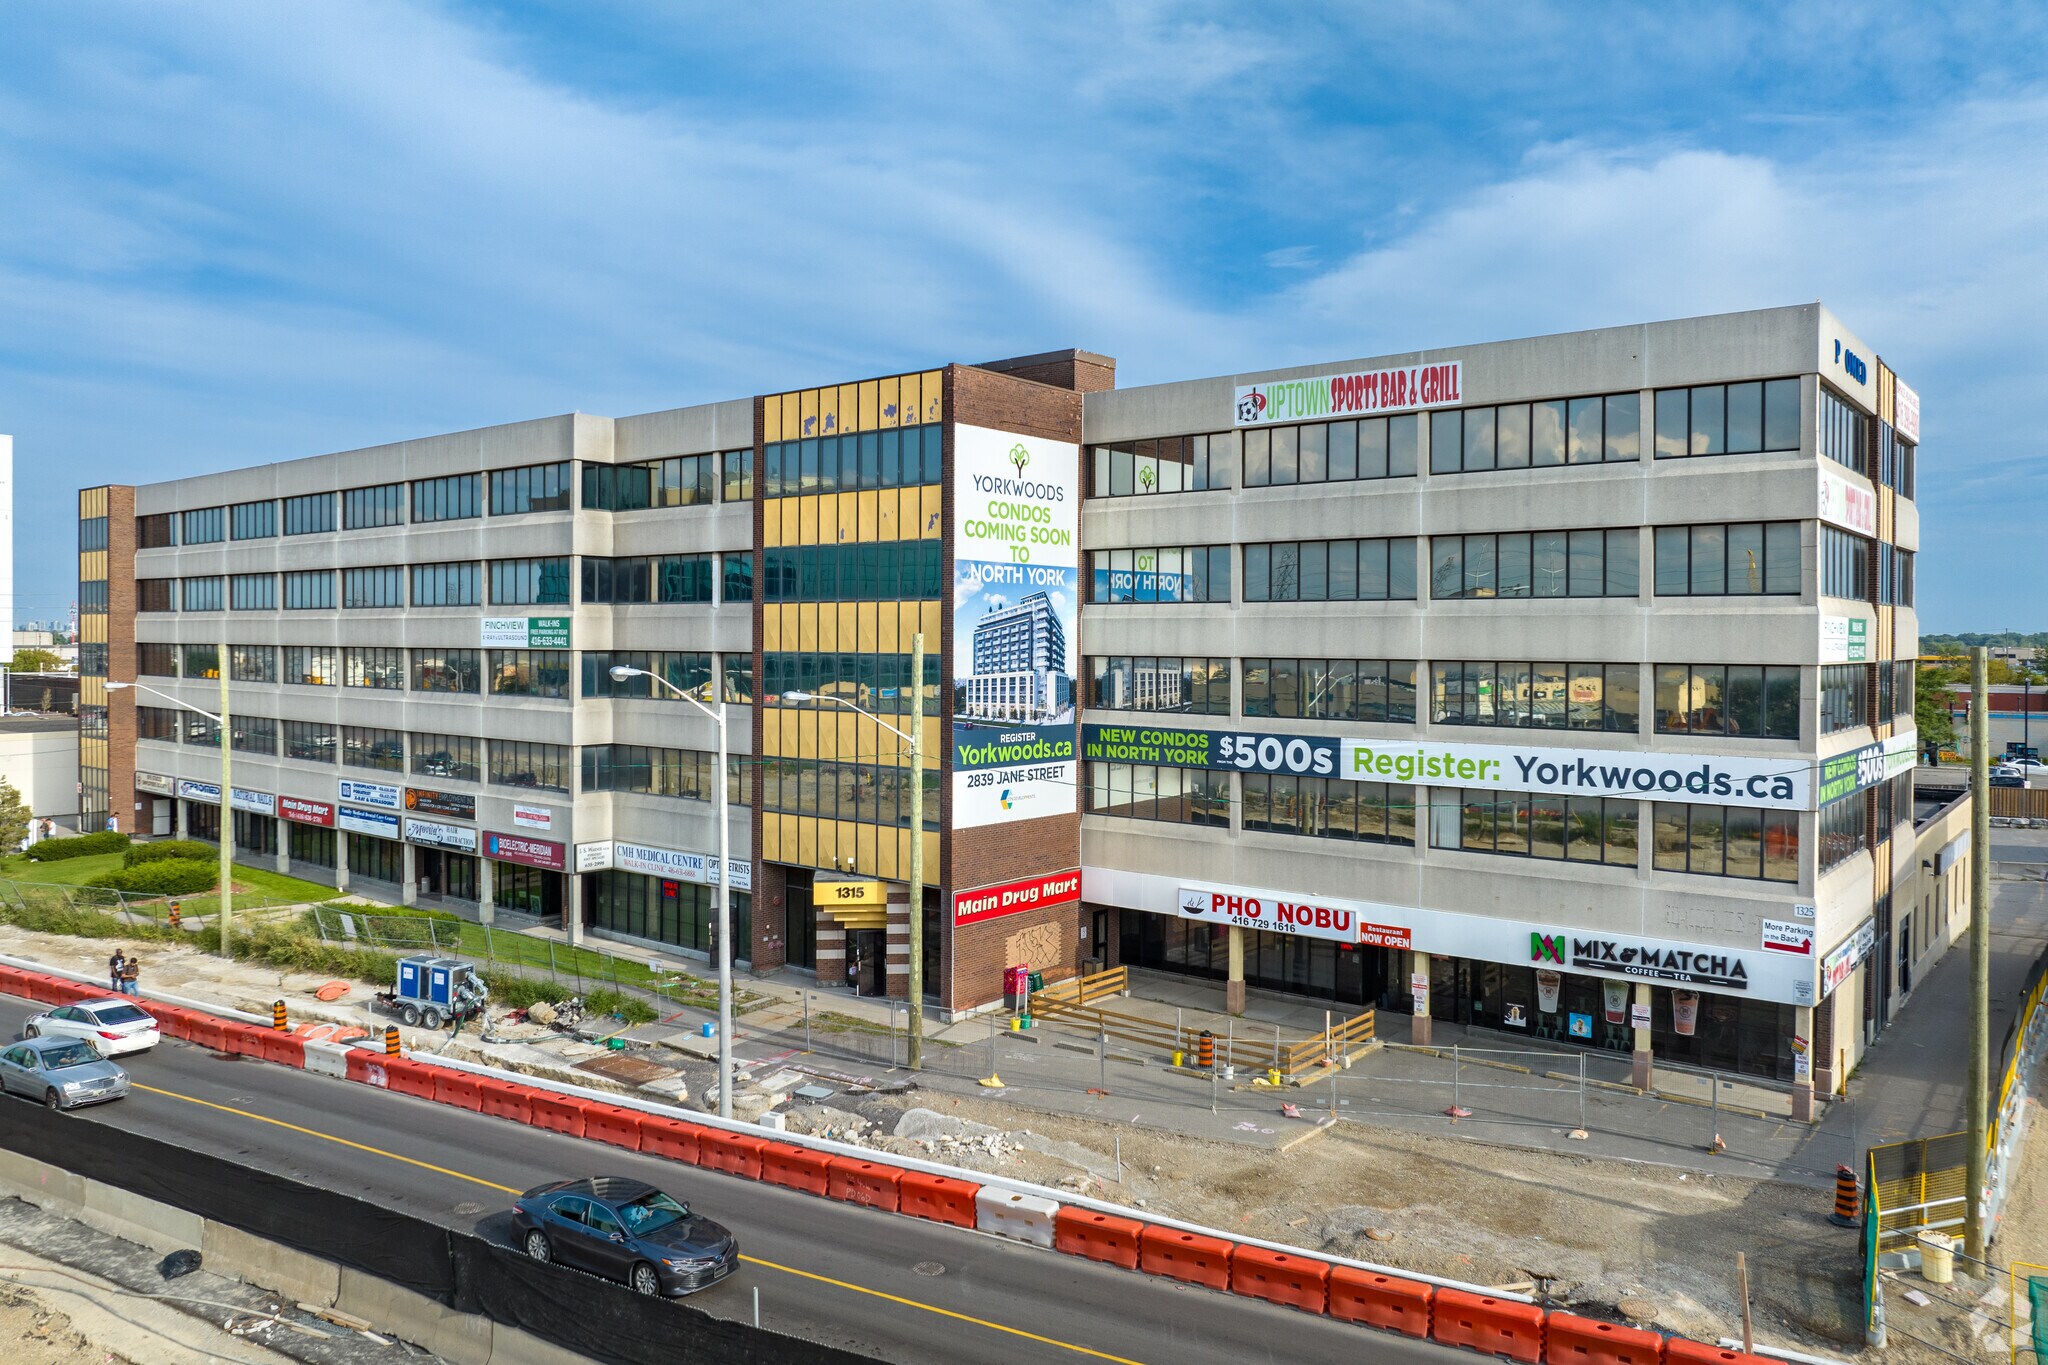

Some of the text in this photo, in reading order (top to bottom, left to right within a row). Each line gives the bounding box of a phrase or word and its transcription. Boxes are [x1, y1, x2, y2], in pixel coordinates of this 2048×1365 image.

[1267, 365, 1459, 420] UPTOWN SPORTS BAR & GRILL
[973, 474, 1063, 501] YORKWOODS
[988, 501, 1051, 523] CONDOS
[965, 520, 1070, 545] COMING SOON
[1010, 546, 1029, 563] TO
[970, 564, 1065, 586] NORTH YORK
[485, 621, 524, 629] FINCHVIEW
[1001, 732, 1036, 743] REGISTER
[1100, 729, 1208, 748] NEW CONDOS
[958, 739, 1072, 765] Yorkwoods.ca
[1087, 744, 1208, 765] IN NORTH YORK
[1220, 736, 1332, 774] $500s
[1353, 747, 1793, 800] Register: Yorkwoods.ca
[1825, 754, 1856, 780] NEW CONDOS
[1858, 746, 1883, 785] $500s
[968, 766, 1064, 788] 2839 JANE STREET
[184, 782, 220, 794] PROMED
[1820, 773, 1856, 804] IN NORTH YORK
[233, 789, 255, 802] NATURAL
[257, 794, 272, 806] NAILS
[282, 799, 328, 815] Main Drug Mart
[446, 826, 458, 834] HAIR
[447, 836, 474, 846] ATTRACTION
[499, 838, 552, 856] BIOELECTRIC-MERIDIAN
[617, 845, 634, 858] CMH
[636, 848, 670, 865] MEDICAL
[672, 854, 703, 870] CENTRE
[624, 859, 646, 870] WALK-IN
[648, 864, 666, 873] CLINIC
[709, 859, 750, 875] OPTETRISTS
[836, 886, 864, 898] 1315
[958, 878, 1077, 917] Main Drug Mart
[1212, 894, 1349, 931] PHO NOBU
[1796, 906, 1814, 916] 1325
[1232, 916, 1296, 932] 416 729 1616
[1368, 925, 1403, 936] Restaurant
[1765, 922, 1814, 937] More Parking
[1361, 932, 1410, 948] NOW OPEN
[1781, 934, 1799, 943] Back
[1573, 938, 1618, 961] MIX
[1641, 946, 1748, 979] MATCHA
[1625, 966, 1692, 982] COFFEE TEA
